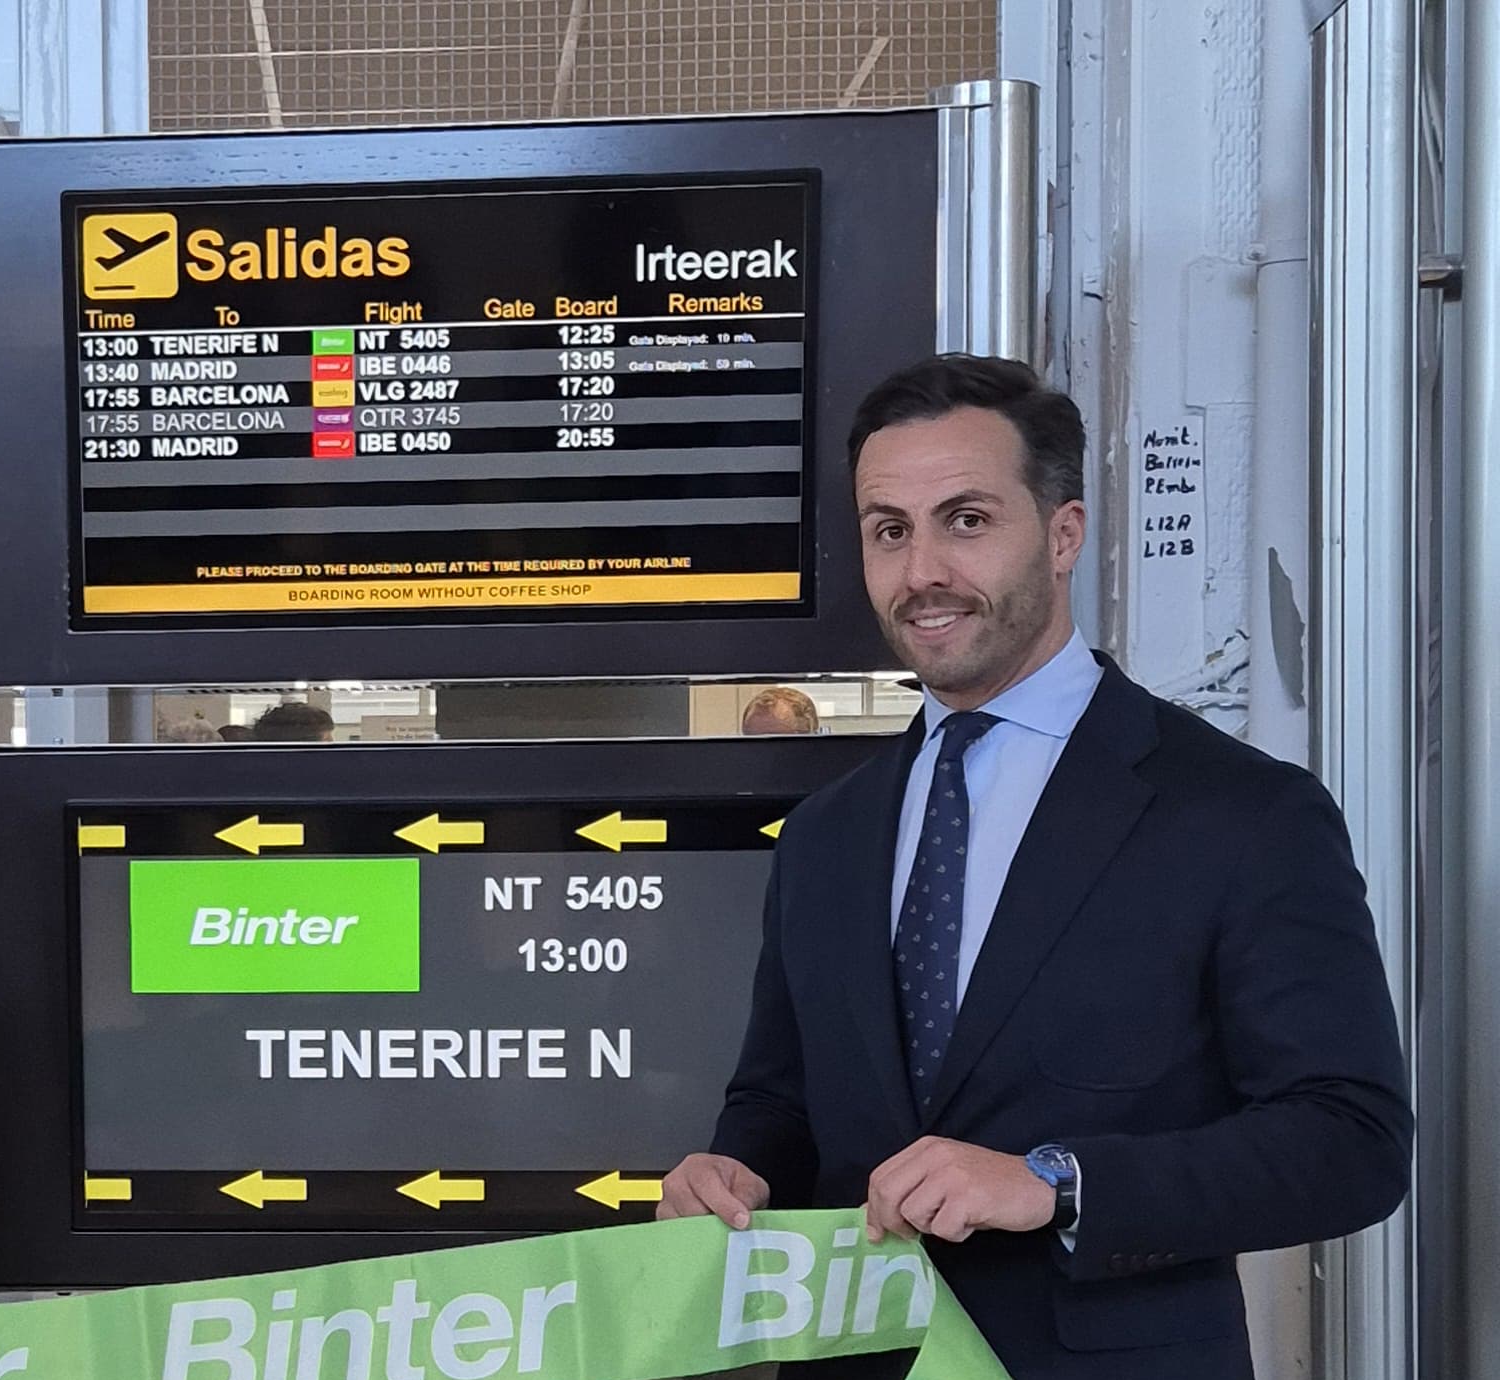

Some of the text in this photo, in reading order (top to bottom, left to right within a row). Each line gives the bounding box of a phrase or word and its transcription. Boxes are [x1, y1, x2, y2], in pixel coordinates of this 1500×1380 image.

[185, 226, 411, 281] Salidas
[637, 240, 799, 283] Irteerak
[84, 292, 763, 329] Time To Flight Gate Board Remarks
[83, 337, 139, 358] 13:00
[150, 334, 257, 355] TENERIFE
[262, 333, 279, 353] N
[359, 331, 390, 350] NT
[400, 329, 450, 349] 5405
[558, 325, 615, 345] 12:25
[84, 363, 139, 382] 13:40
[151, 361, 238, 381] MADRID
[359, 356, 397, 376] IBE
[401, 354, 451, 375] 0446
[558, 351, 615, 371] 13:05
[84, 376, 615, 408] 17:55 BARCELONA VLG 2487 17:20
[87, 413, 140, 433] 17:55
[152, 411, 285, 431] BARCELONA
[360, 407, 406, 428] QTR
[411, 406, 461, 426] 3745
[559, 402, 614, 422] 17:20
[84, 428, 615, 459] 21:30 MADRID IBE 0450 20:55
[197, 556, 692, 579] PLEASE PROCEED TO THE BOARDING GATE AT THE TIME REQUIRED BY YOUR AIRLINE
[288, 583, 592, 602] BOARDING ROOM WITHOUT COFFEE SHOP
[484, 875, 664, 911] NT 5405
[190, 907, 358, 946] Binter
[518, 938, 628, 972] 13:00
[246, 1028, 632, 1079] TENERIFE N
[717, 1227, 937, 1349] Bin
